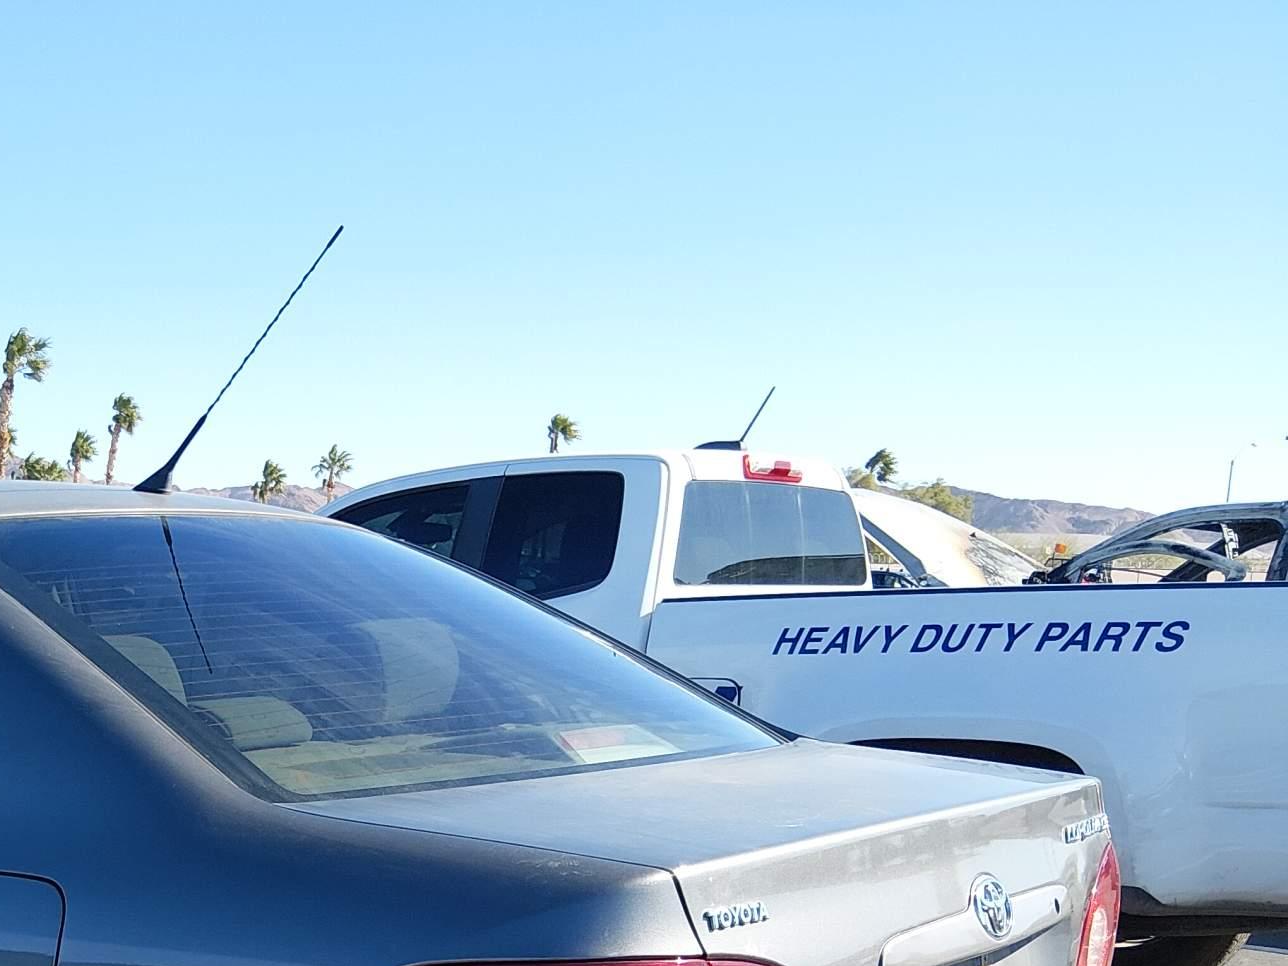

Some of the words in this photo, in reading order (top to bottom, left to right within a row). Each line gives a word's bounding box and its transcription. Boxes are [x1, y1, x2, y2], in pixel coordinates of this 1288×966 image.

[772, 624, 910, 655] HEAVY
[910, 623, 1033, 654] DUTY
[1034, 620, 1191, 653] PARTS
[702, 901, 769, 932] TOYOTA
